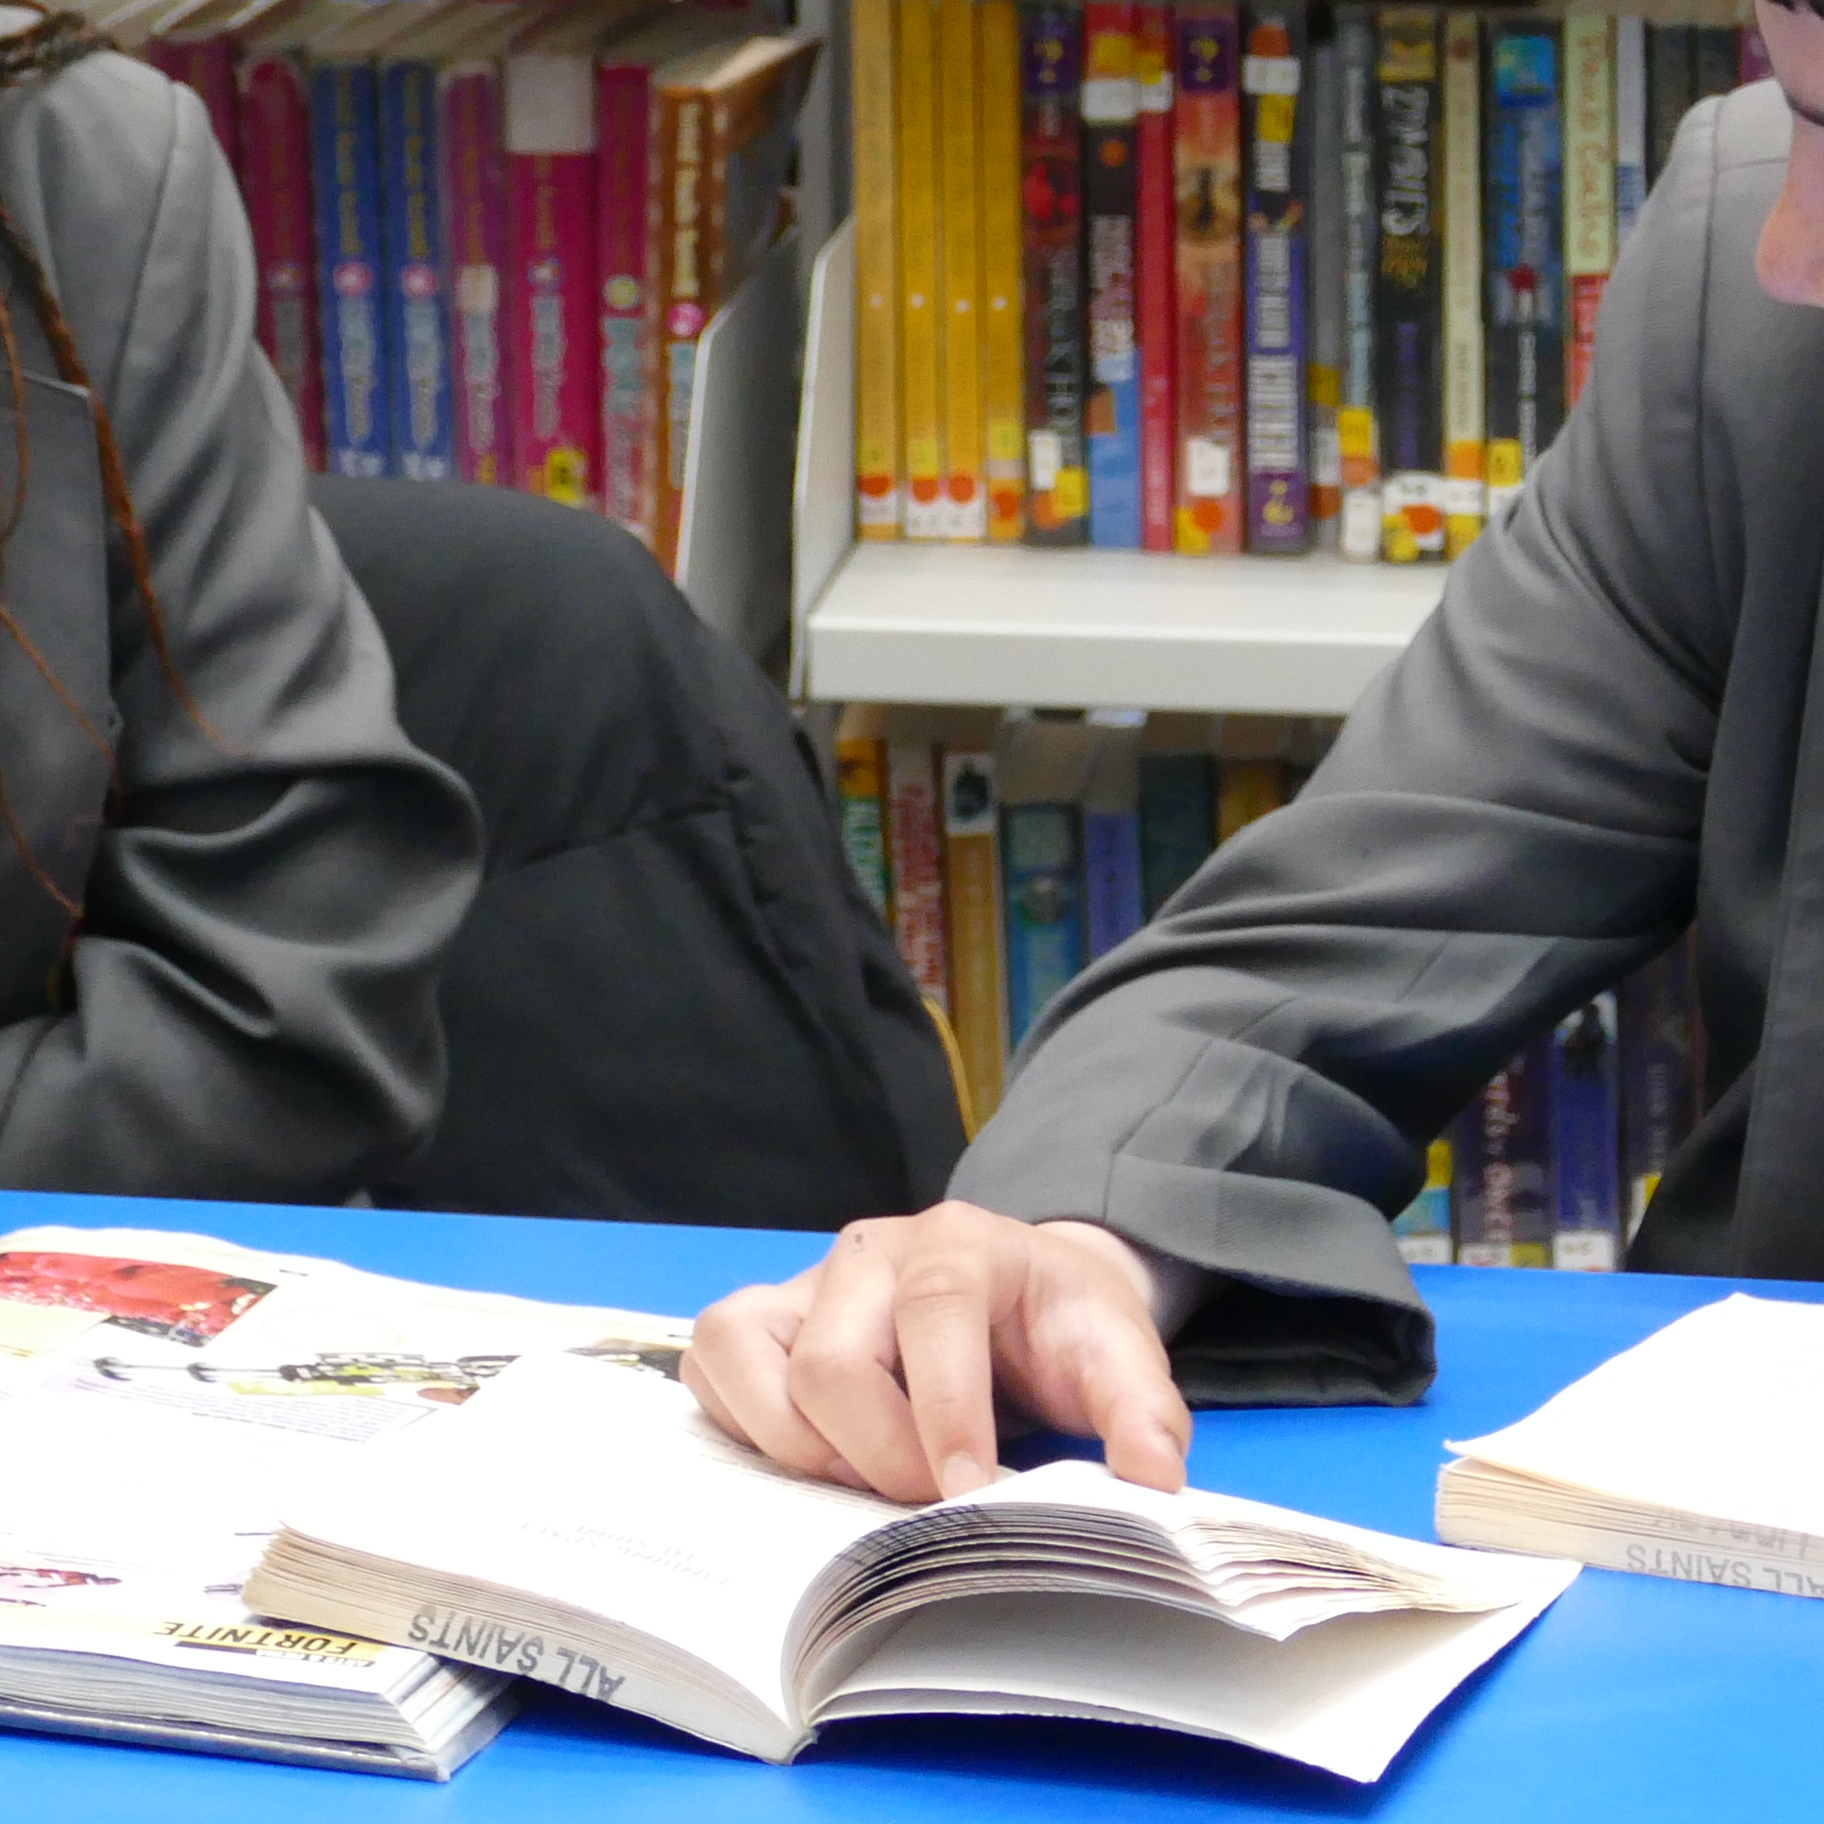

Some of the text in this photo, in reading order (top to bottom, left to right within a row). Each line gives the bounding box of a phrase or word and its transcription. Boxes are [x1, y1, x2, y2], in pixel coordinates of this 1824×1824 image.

[1625, 1543, 1753, 1589] SAINTS
[153, 1621, 357, 1655] FORTNITE
[407, 1603, 628, 1700] ALL SAINTS
